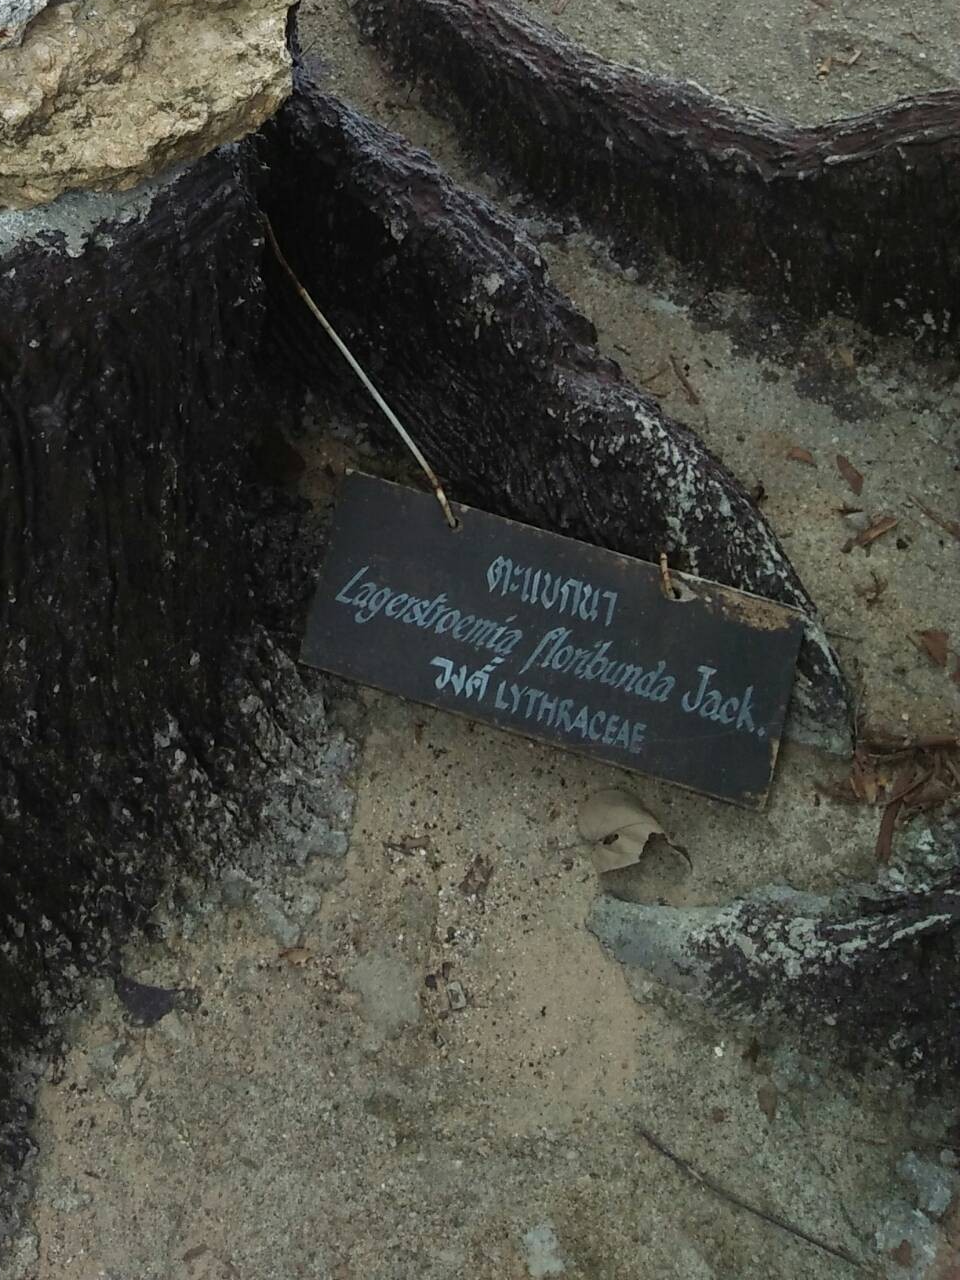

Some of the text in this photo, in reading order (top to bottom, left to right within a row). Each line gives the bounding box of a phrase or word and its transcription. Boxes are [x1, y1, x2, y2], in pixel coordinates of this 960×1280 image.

[486, 555, 619, 627] ตะแบกนา
[335, 566, 766, 737] Lagerstroemia floribunda Jack.
[495, 679, 647, 754] LYTHRACEAE
